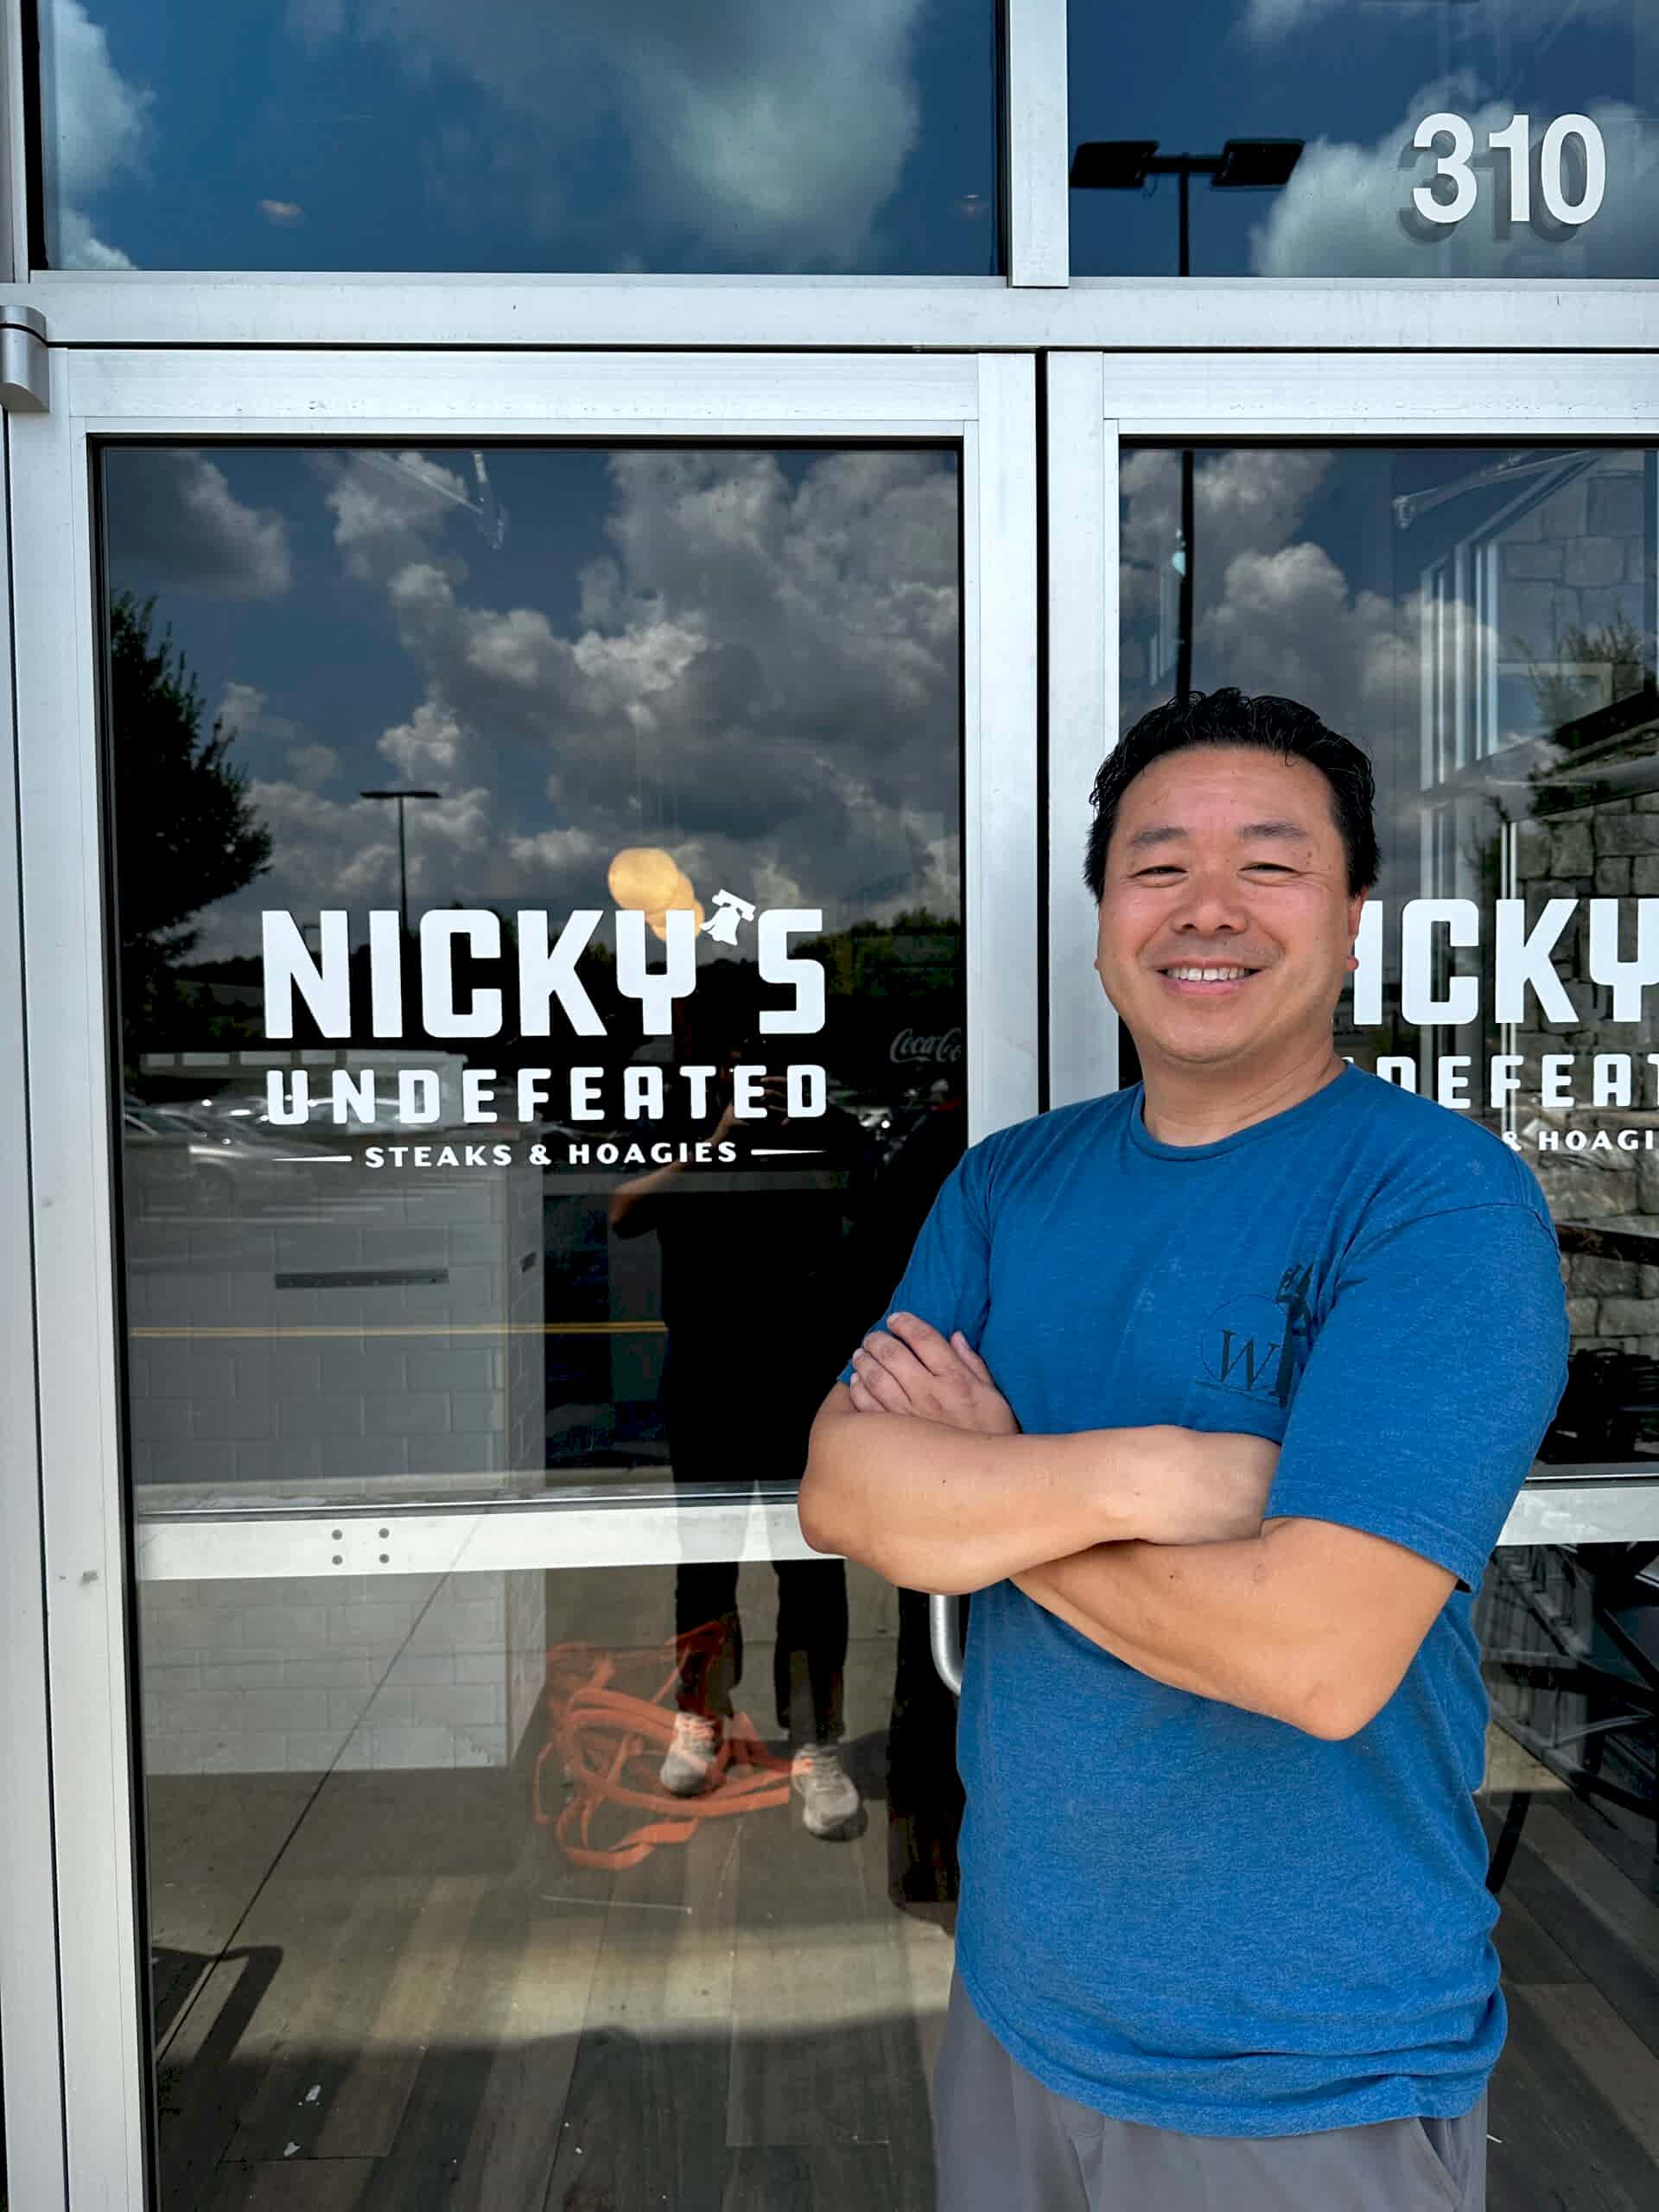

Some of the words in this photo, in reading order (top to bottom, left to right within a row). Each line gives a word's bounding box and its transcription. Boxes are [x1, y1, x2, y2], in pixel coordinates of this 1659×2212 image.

[1413, 112, 1605, 225] 310
[262, 888, 825, 1039] NICKY'S
[265, 1065, 827, 1125] UNDEFEATED
[1341, 1054, 1659, 1109] DEFEA
[365, 1145, 512, 1169] STEAKS
[529, 1144, 551, 1166] &
[569, 1141, 737, 1166] HOAGIES
